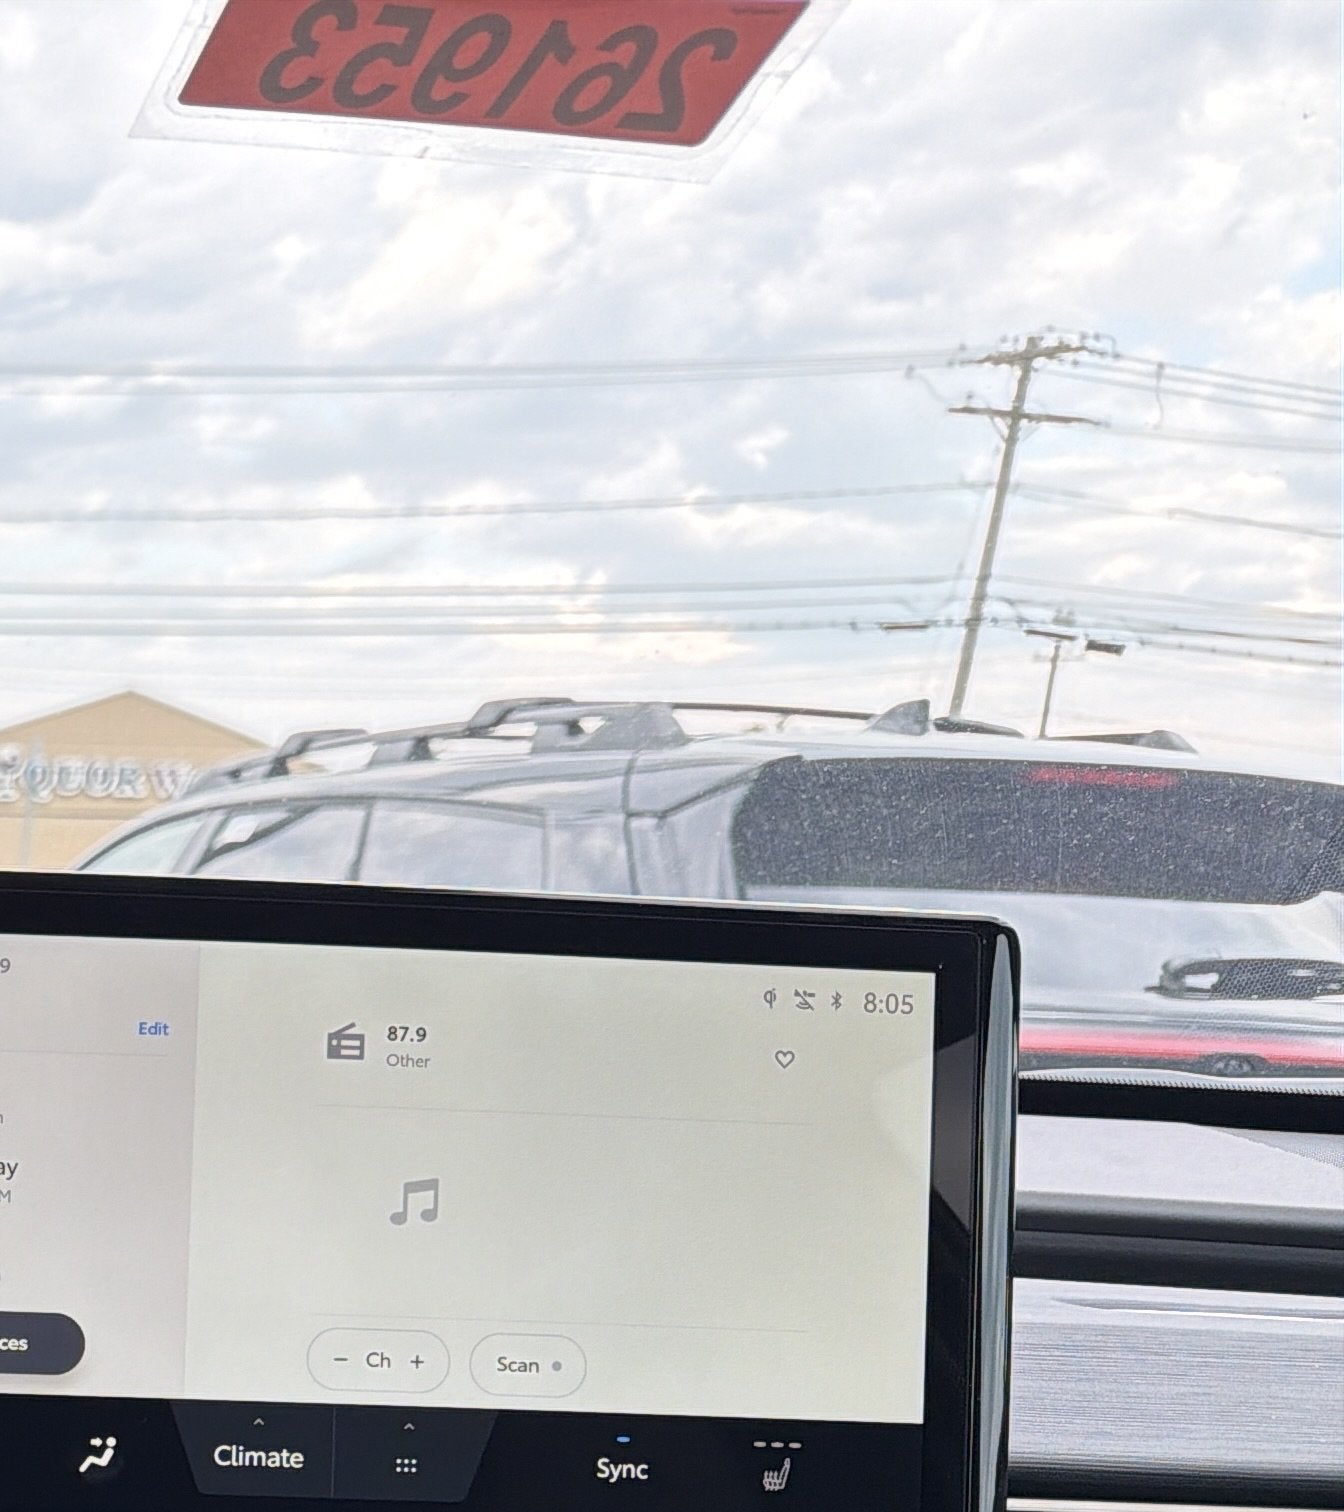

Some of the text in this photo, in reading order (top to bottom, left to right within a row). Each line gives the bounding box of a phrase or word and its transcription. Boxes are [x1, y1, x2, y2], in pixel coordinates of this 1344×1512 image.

[863, 991, 914, 1015] 8:05
[138, 1021, 170, 1036] Edit
[386, 1026, 428, 1043] 87.9
[386, 1053, 431, 1069] Other
[365, 1351, 391, 1368] Ch
[496, 1356, 540, 1373] Scan
[213, 1445, 305, 1470] Climate
[596, 1457, 649, 1483] Sync
